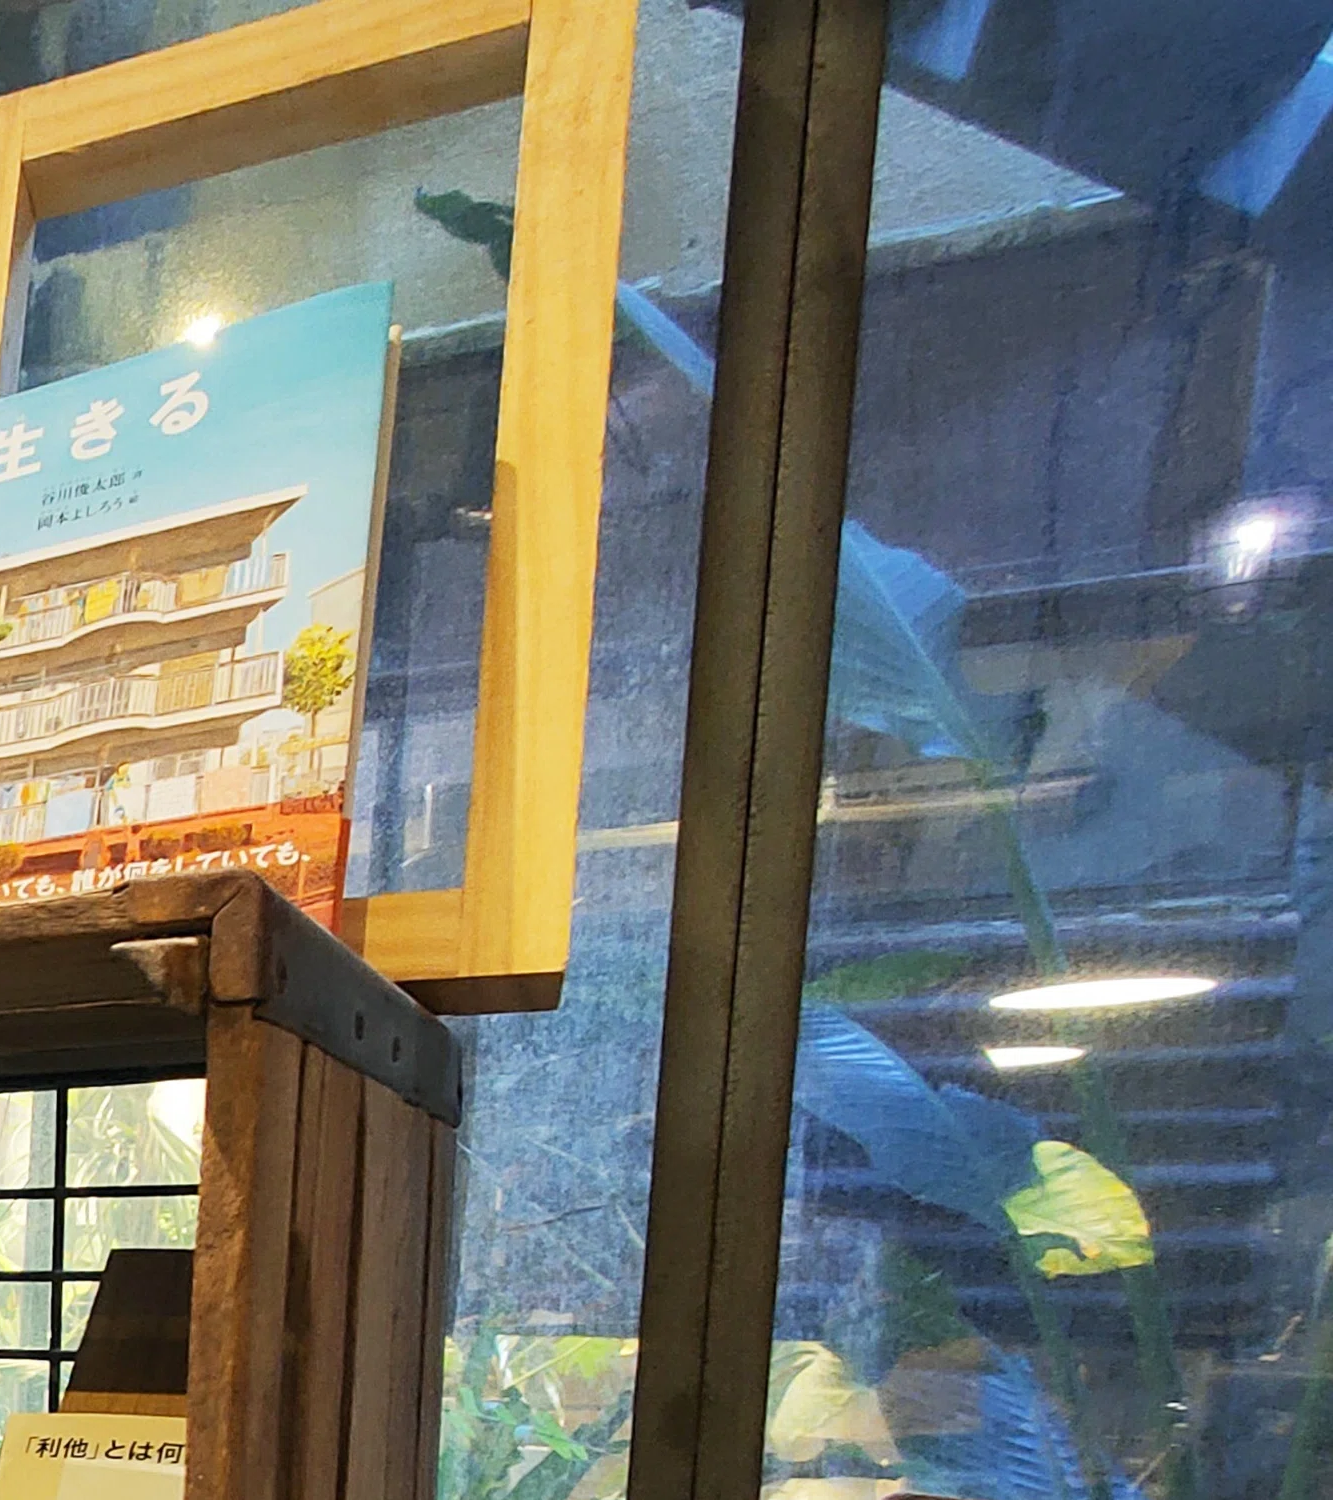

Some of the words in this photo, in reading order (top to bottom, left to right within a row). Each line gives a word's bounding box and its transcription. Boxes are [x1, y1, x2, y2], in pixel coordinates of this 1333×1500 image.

[41, 471, 126, 507] 谷川俊太郎
[36, 497, 124, 531] 岡本よしろう
[24, 1434, 186, 1466] 「利他」とは何
